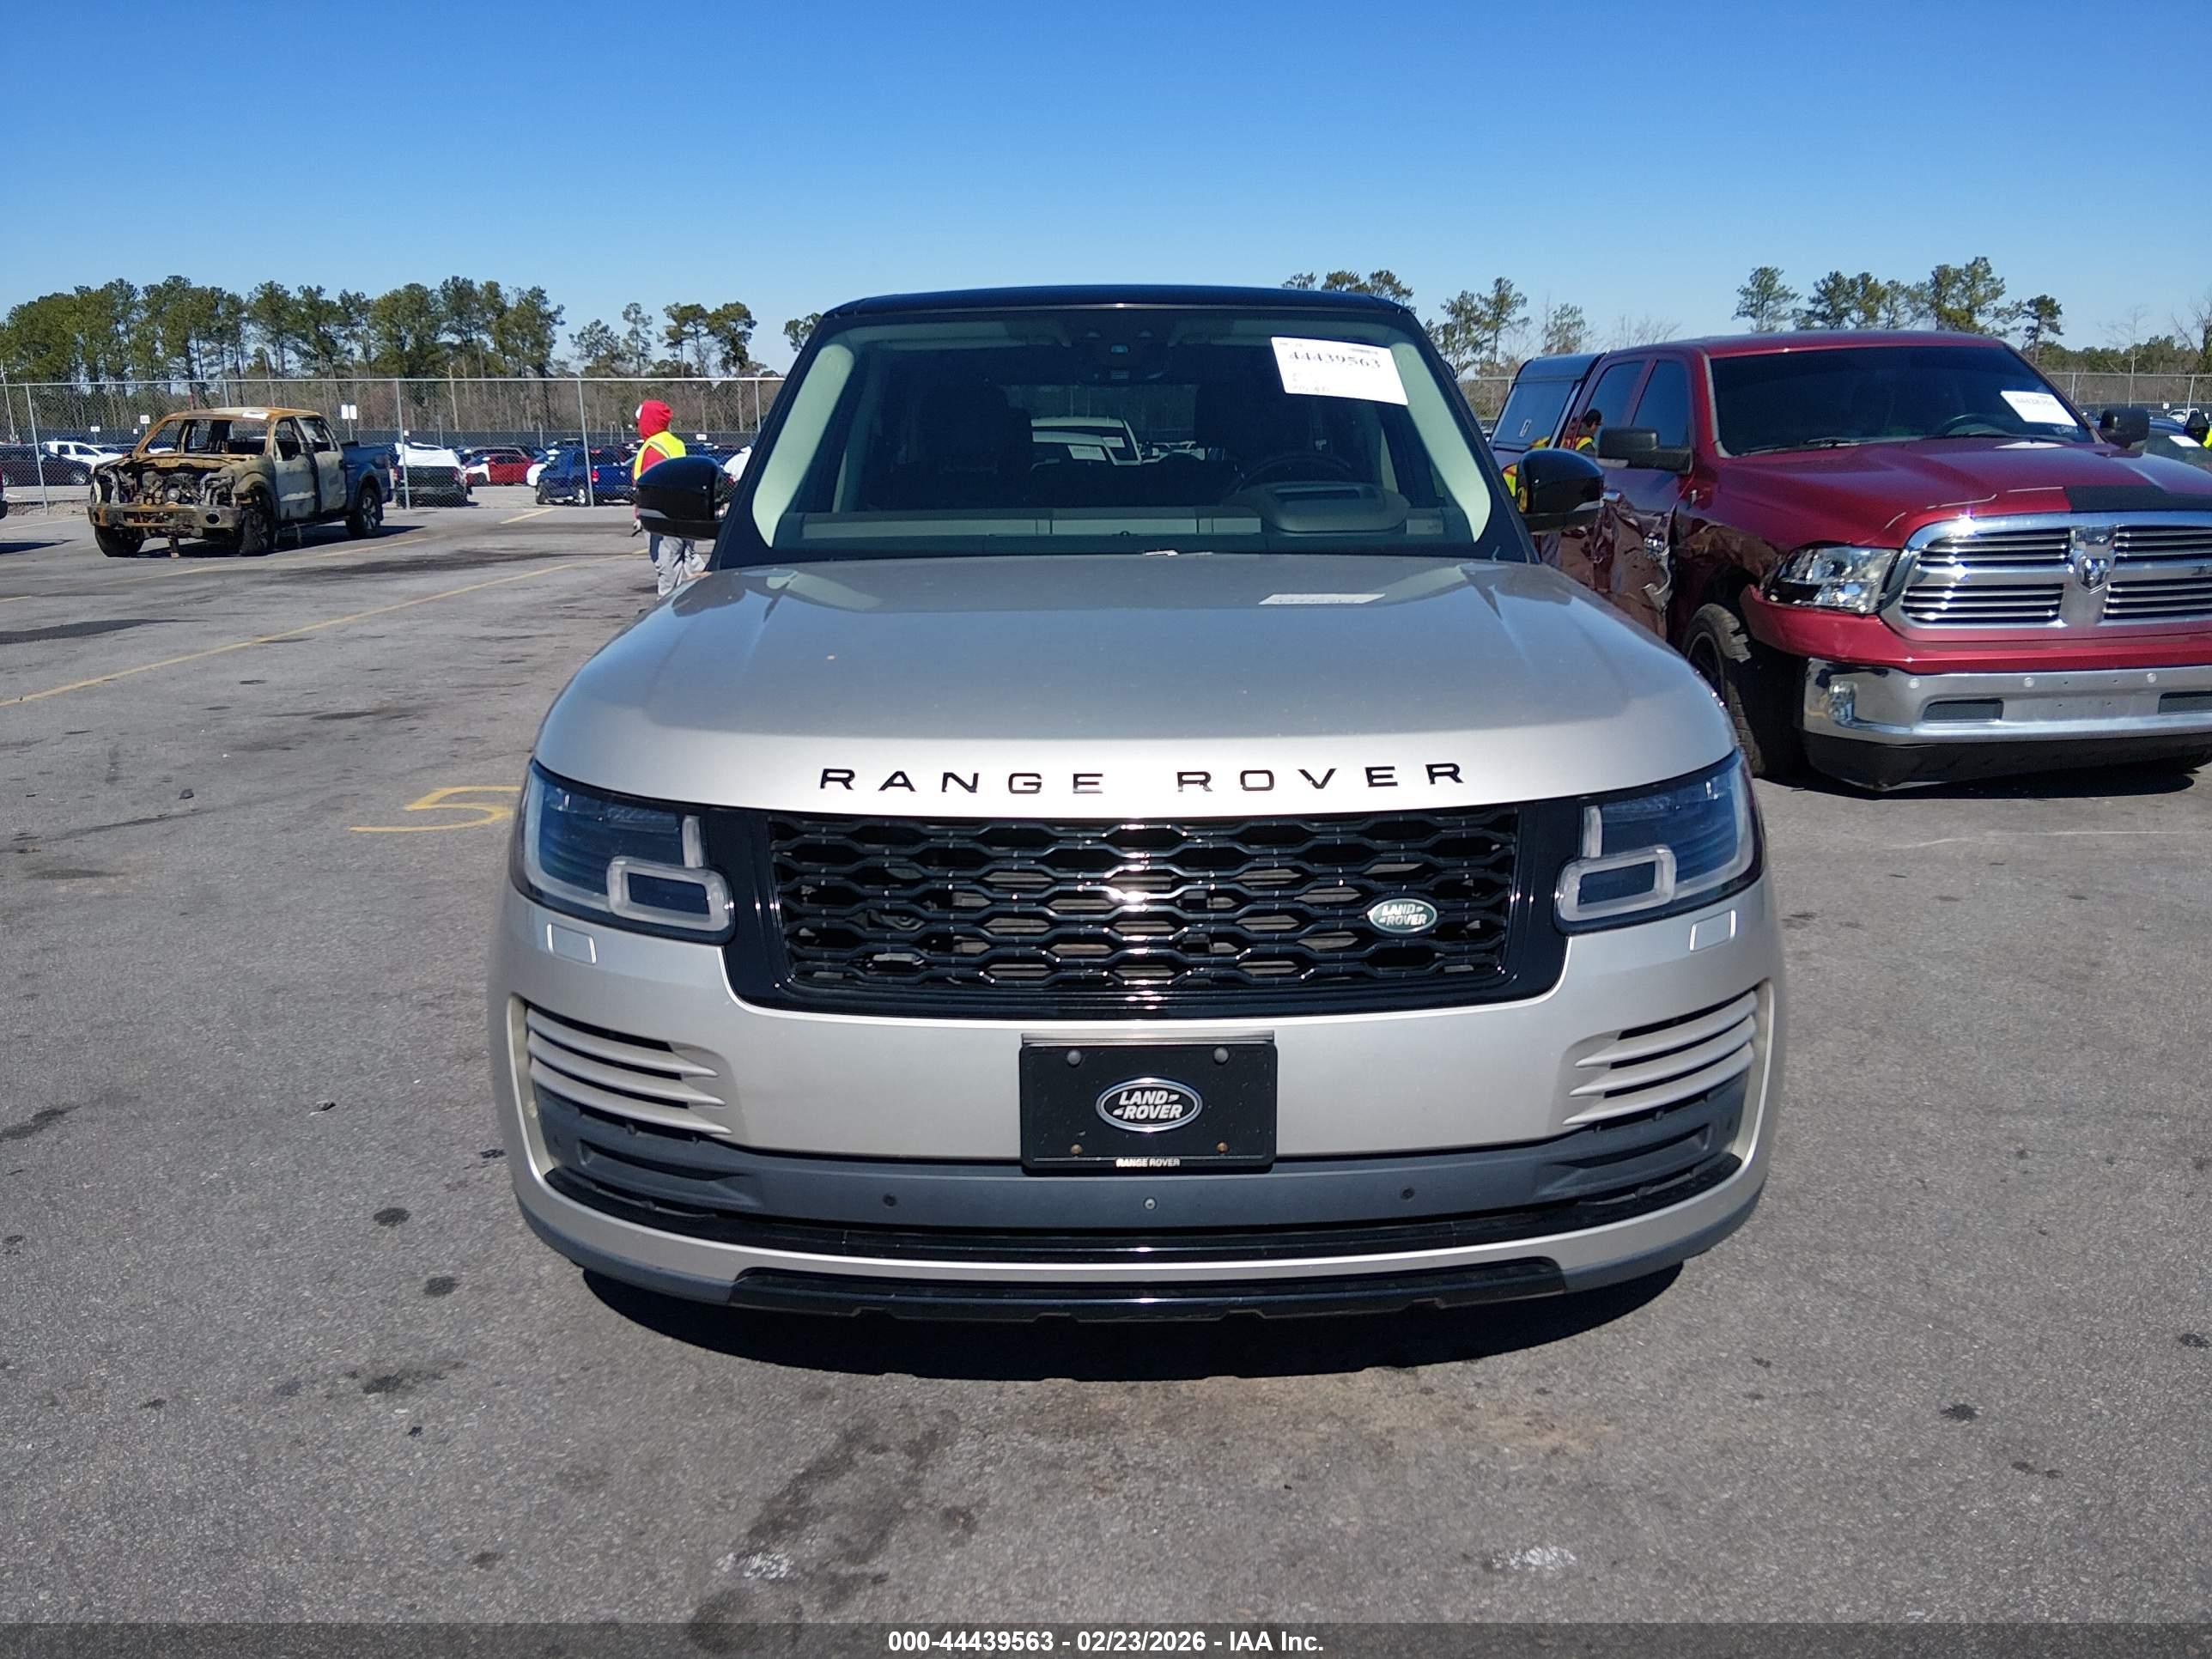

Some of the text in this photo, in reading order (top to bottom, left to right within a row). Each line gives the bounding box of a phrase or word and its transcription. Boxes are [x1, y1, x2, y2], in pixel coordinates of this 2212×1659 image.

[1290, 351, 1381, 369] 44439563
[819, 763, 1465, 794] RANGE ROVER
[1382, 903, 1416, 915] LAND
[1386, 914, 1427, 925] ROVER
[1119, 1091, 1169, 1105] LAND
[1123, 1104, 1183, 1119] ROVER
[1116, 1158, 1181, 1168] RANGE ROVER
